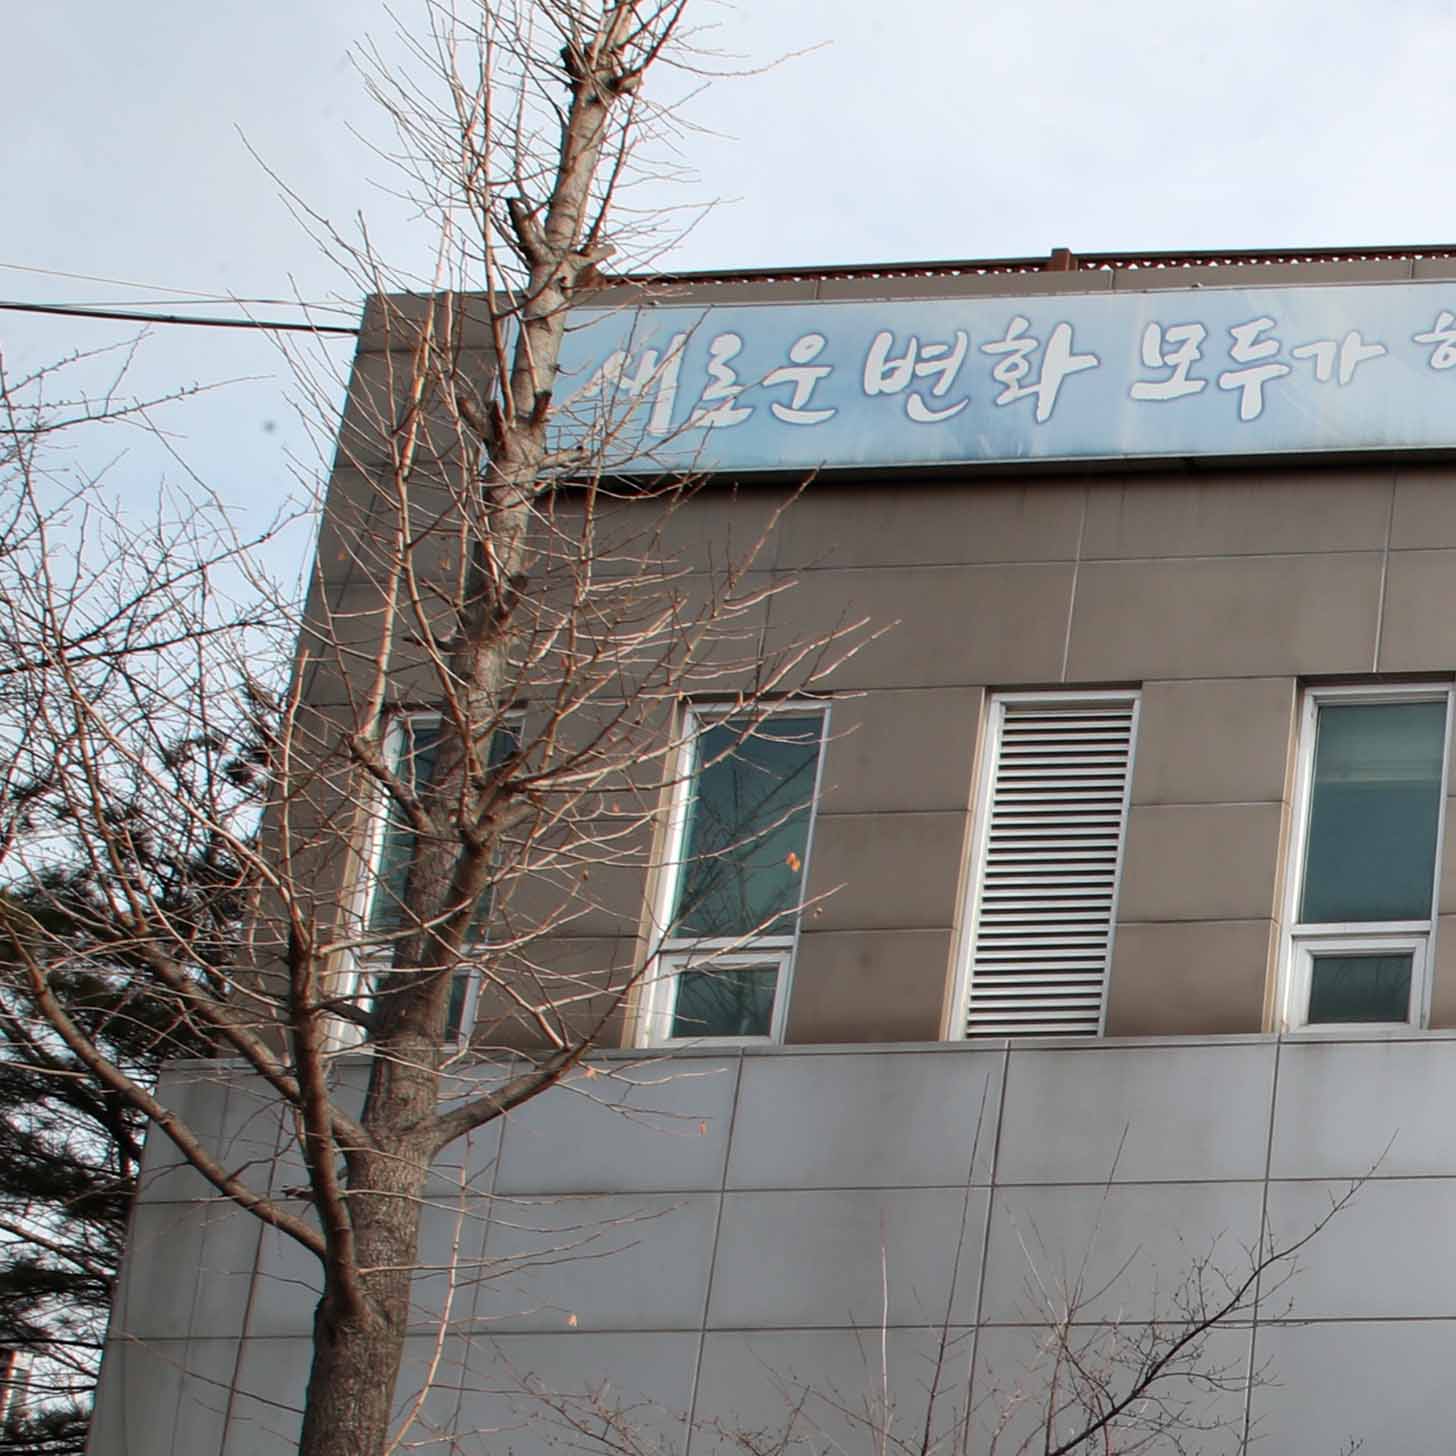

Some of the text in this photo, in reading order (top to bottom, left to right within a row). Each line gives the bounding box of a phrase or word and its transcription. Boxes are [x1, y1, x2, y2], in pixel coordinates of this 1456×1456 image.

[585, 331, 838, 436] 새로운
[863, 317, 1100, 424] 변화
[1129, 319, 1387, 421] 모두가
